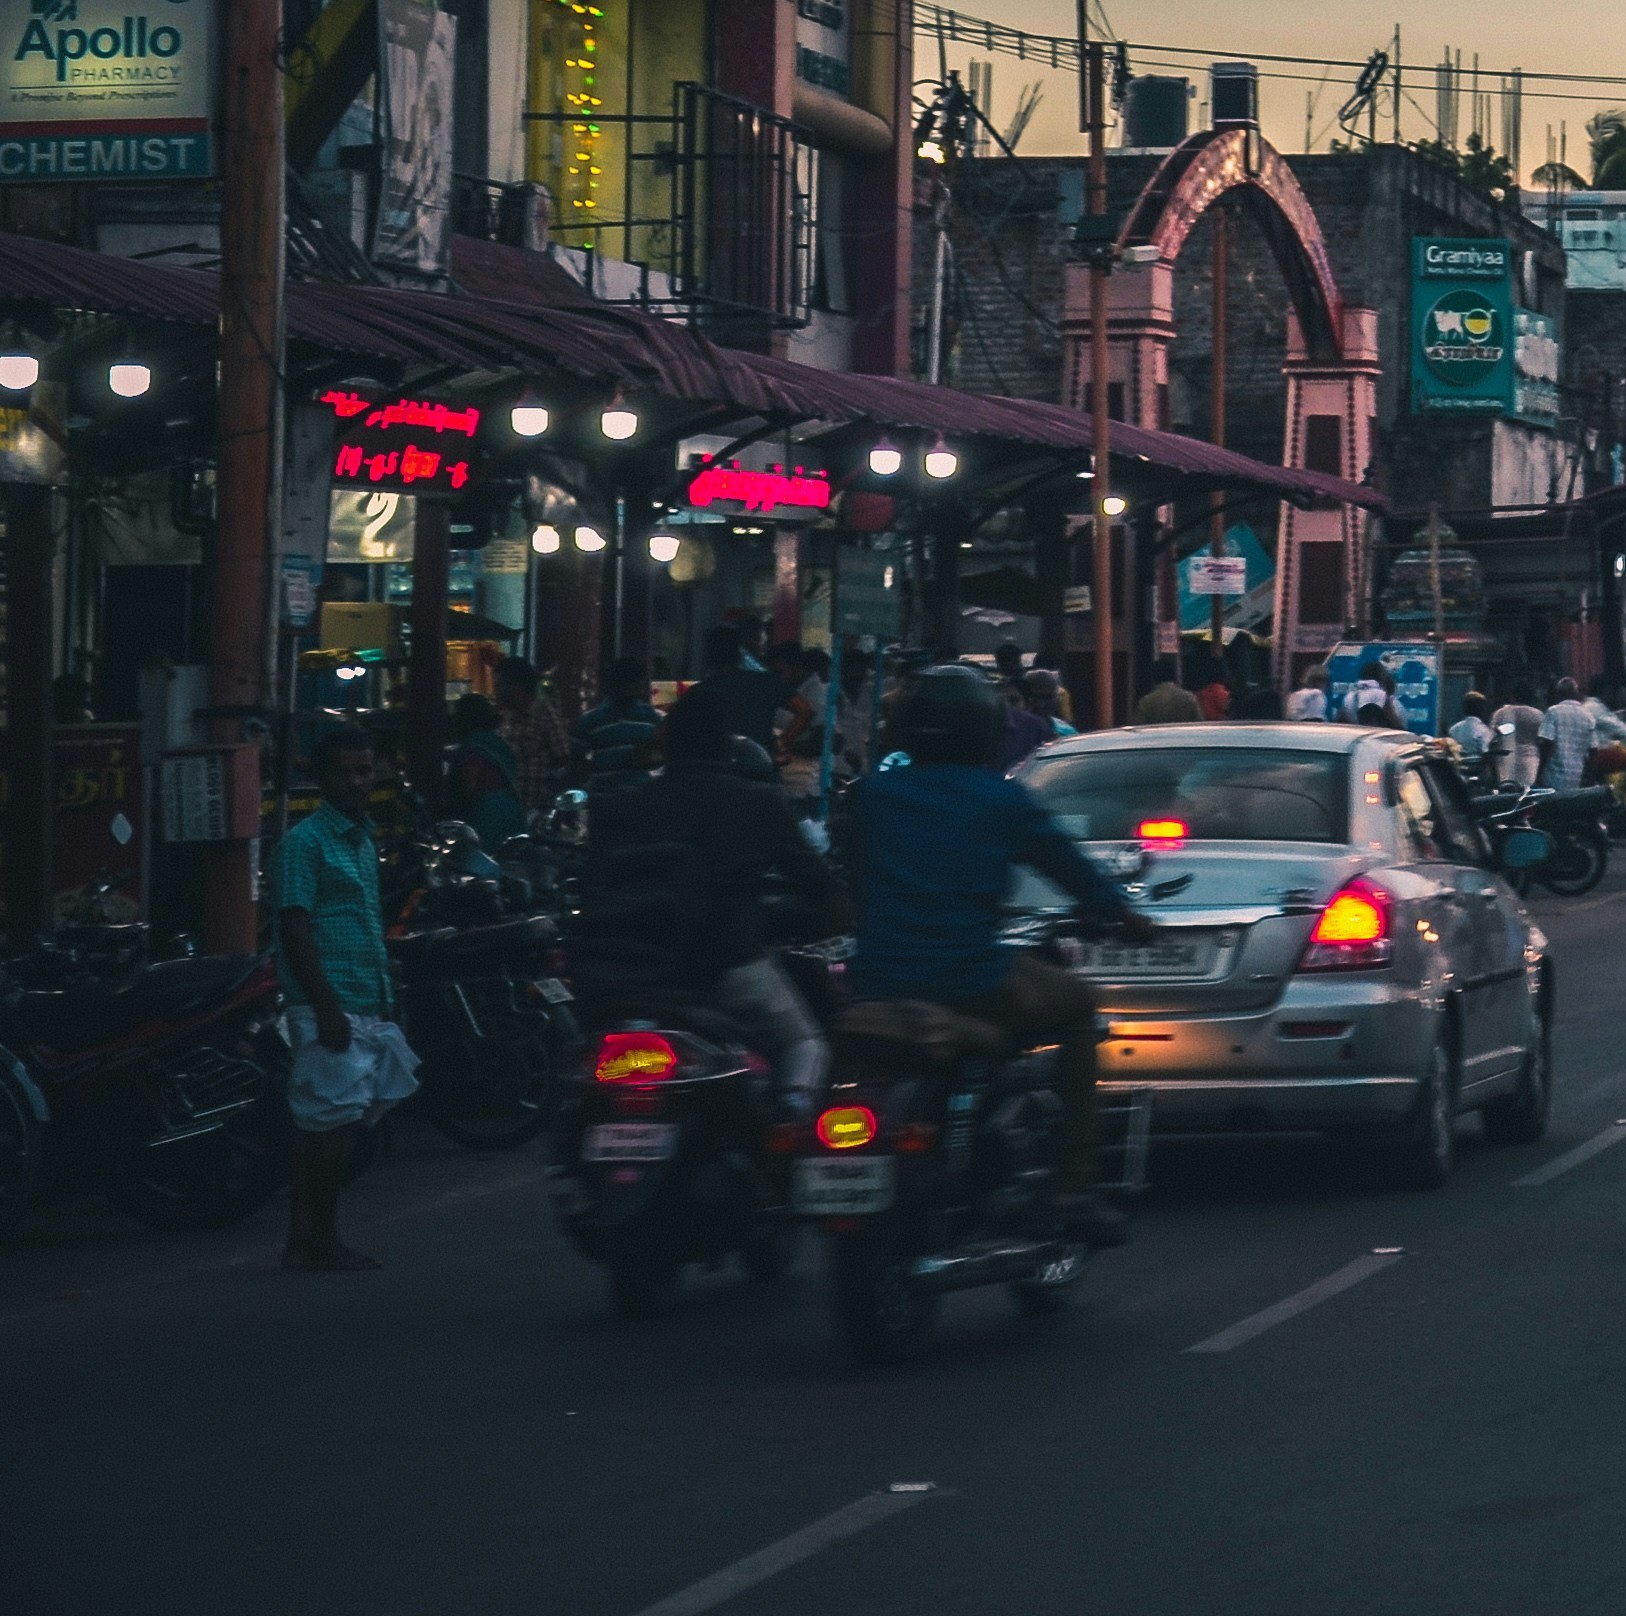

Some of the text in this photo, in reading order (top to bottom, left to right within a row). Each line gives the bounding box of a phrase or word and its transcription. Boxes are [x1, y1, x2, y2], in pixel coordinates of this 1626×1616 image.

[14, 16, 182, 81] Apollo
[71, 66, 182, 81] PHARMACY
[0, 138, 195, 175] CHEMIST
[1426, 245, 1504, 267] Gramiyaa
